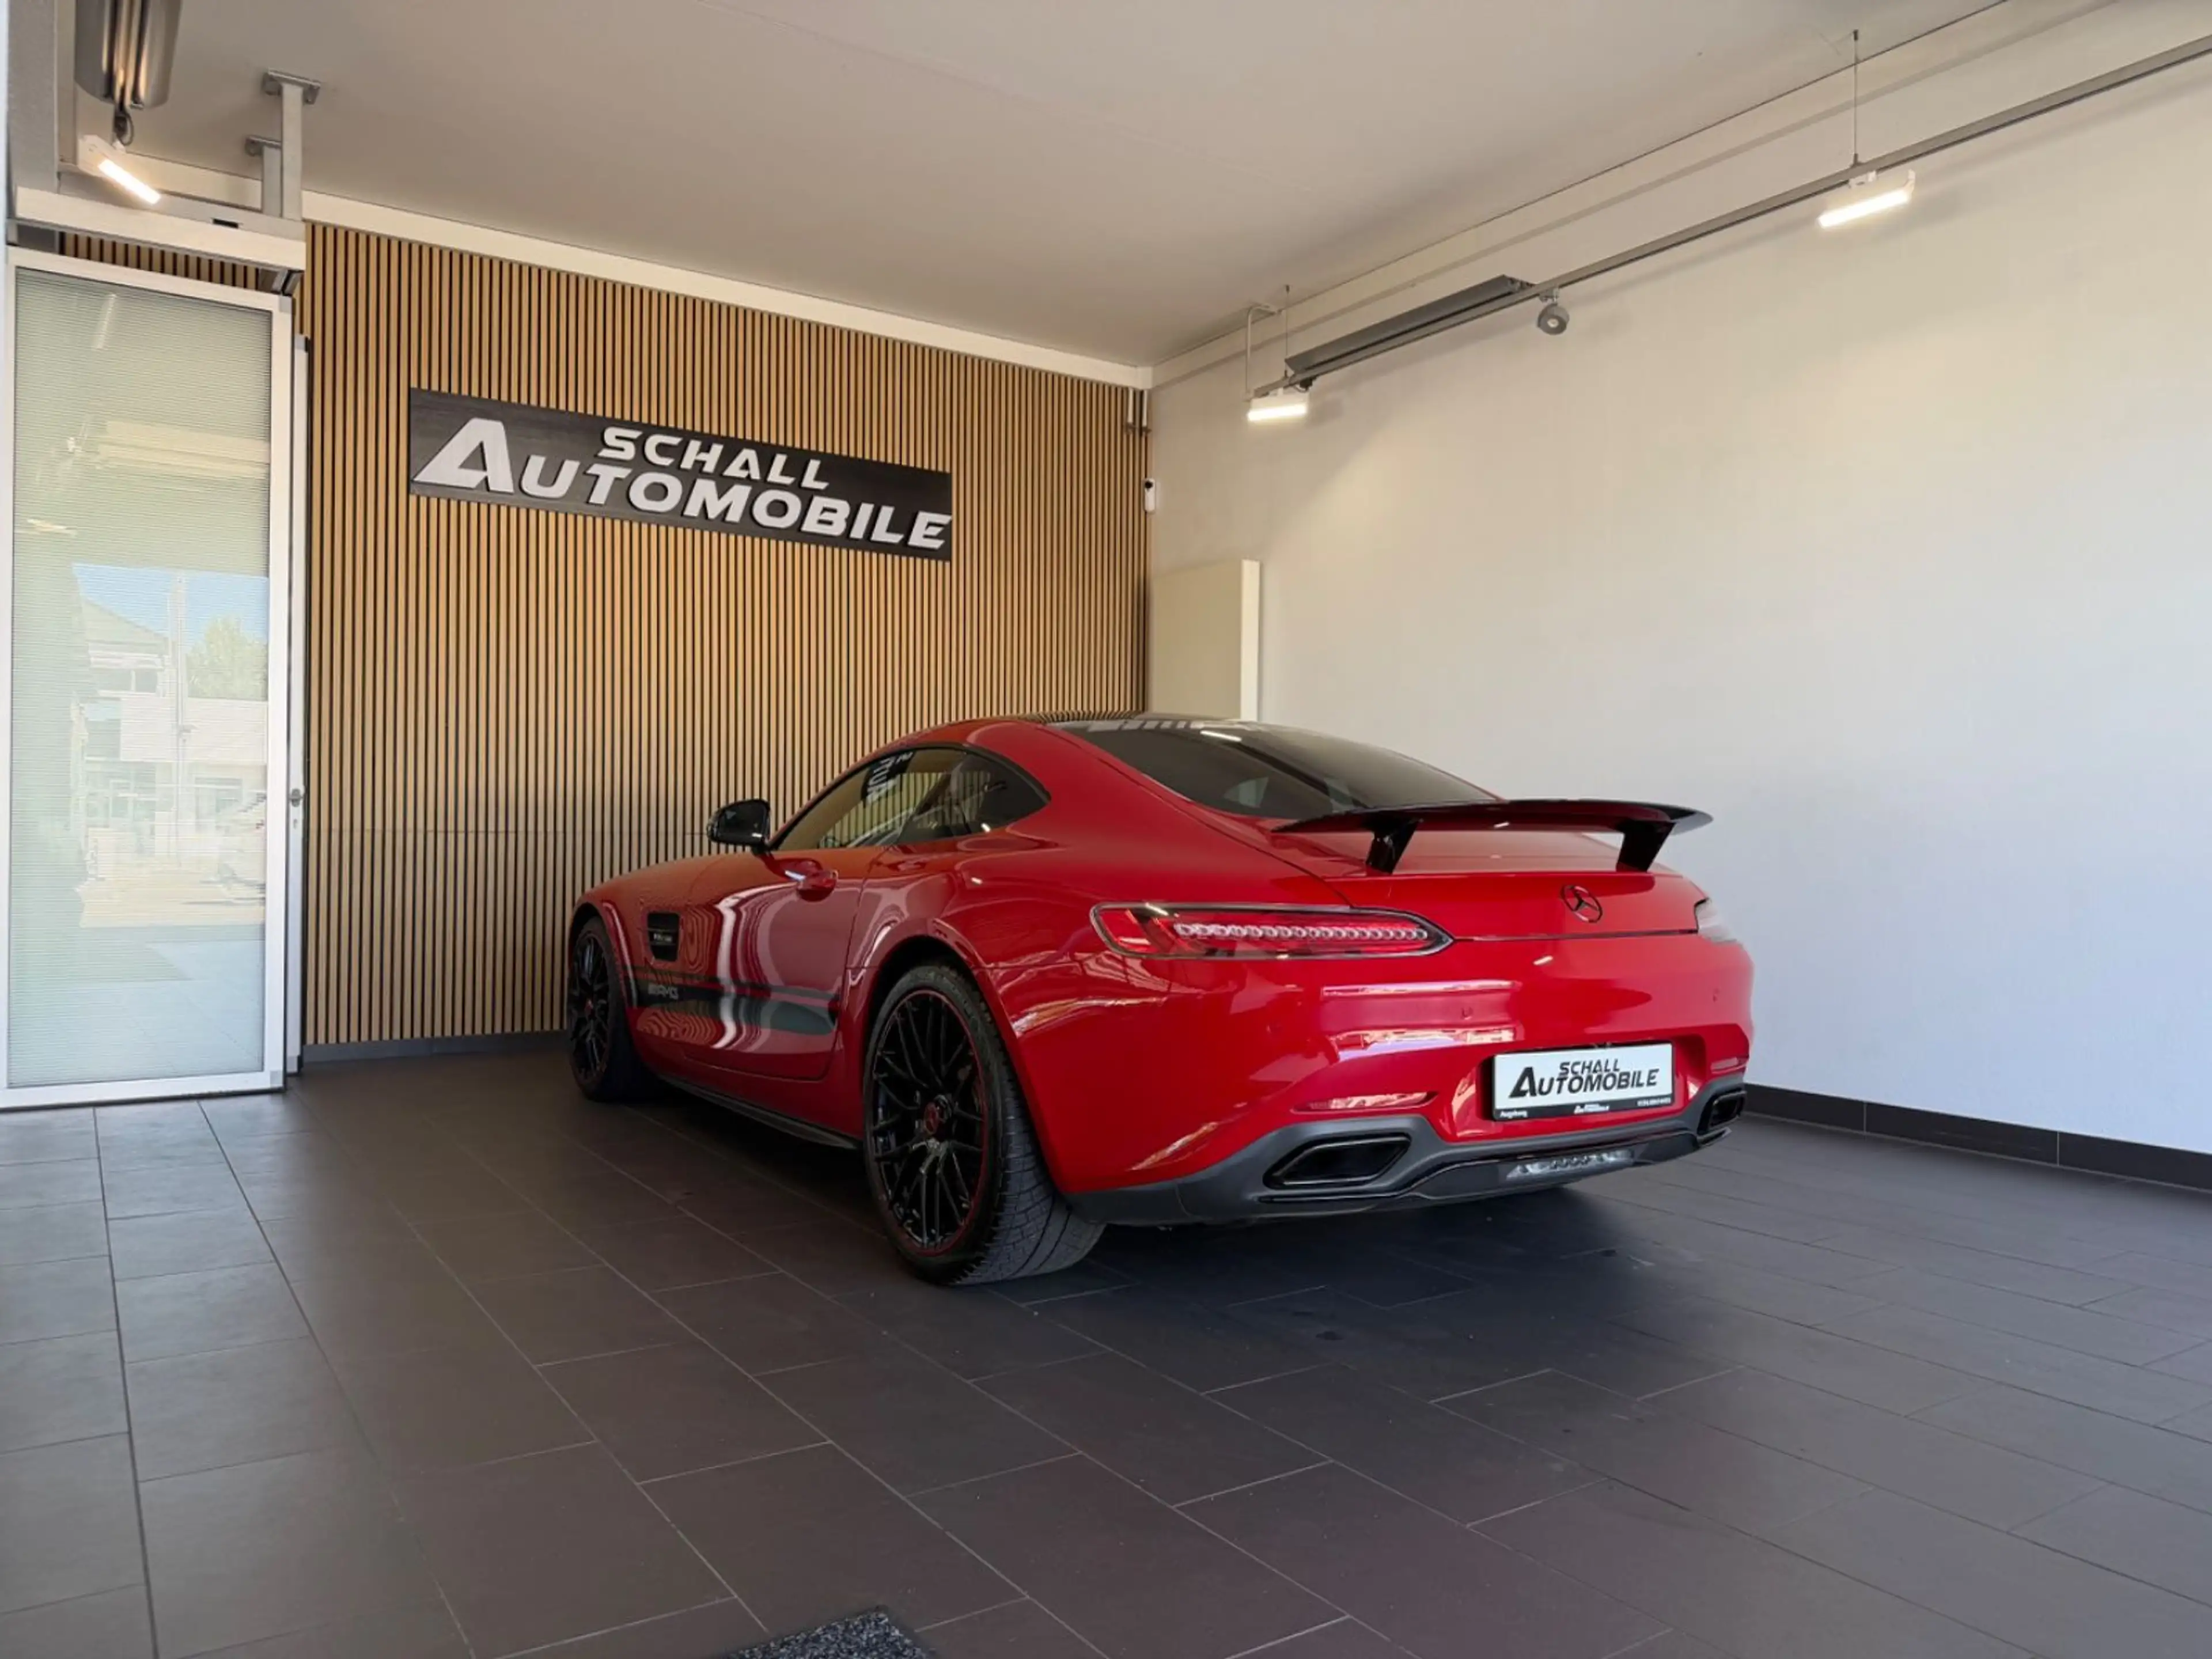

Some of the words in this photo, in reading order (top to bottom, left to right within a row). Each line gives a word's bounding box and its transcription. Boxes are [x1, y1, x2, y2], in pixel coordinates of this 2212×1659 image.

[597, 426, 830, 490] SCHALL
[412, 417, 952, 550] AUTOMOBILE
[1509, 1066, 1660, 1098] AUTOMOBILE
[1559, 1059, 1620, 1076] SCHALL
